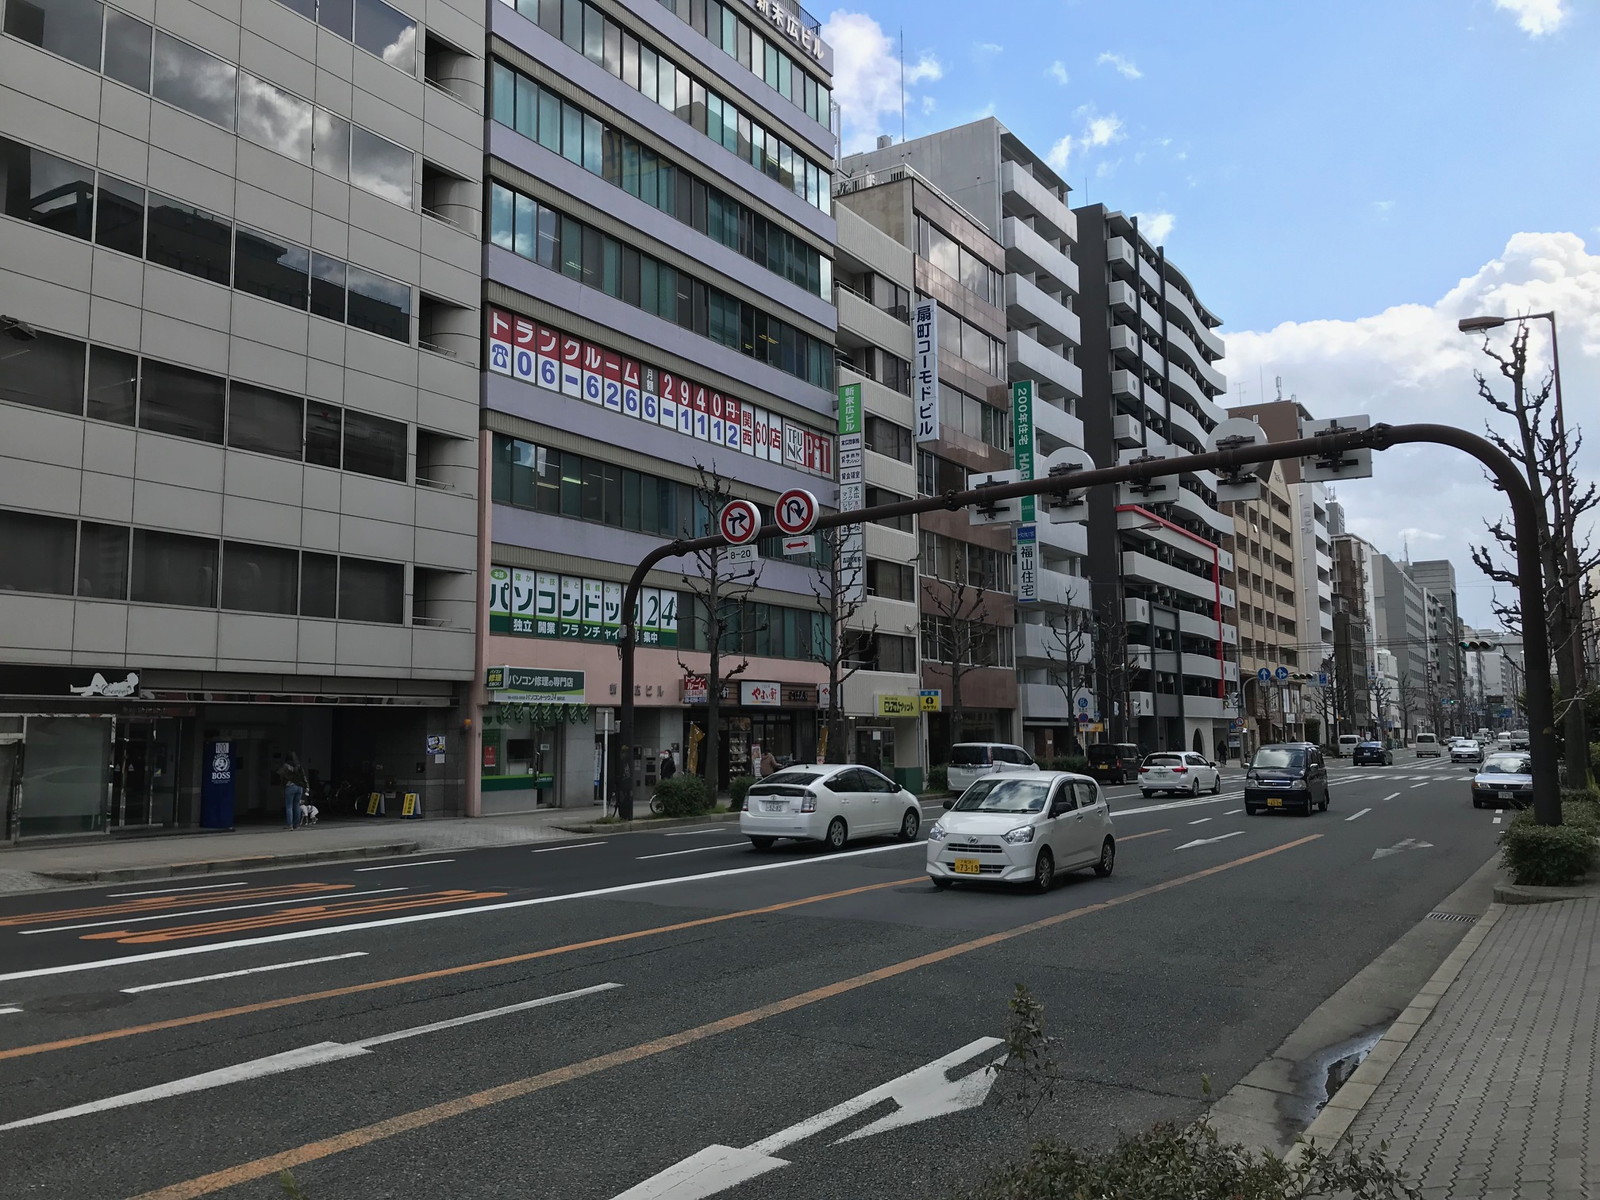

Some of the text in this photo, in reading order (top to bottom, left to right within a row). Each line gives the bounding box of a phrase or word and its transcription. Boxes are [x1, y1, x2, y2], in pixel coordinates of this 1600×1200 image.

[493, 311, 640, 386] トランクルーム
[917, 305, 934, 437] 扇町コーモドビル
[517, 350, 739, 446] 06-6266-1112
[730, 549, 751, 560] 8-20
[1020, 545, 1034, 597] 福山住宅
[508, 674, 573, 688] パソコン修理の専門店
[211, 771, 231, 779] BOSS
